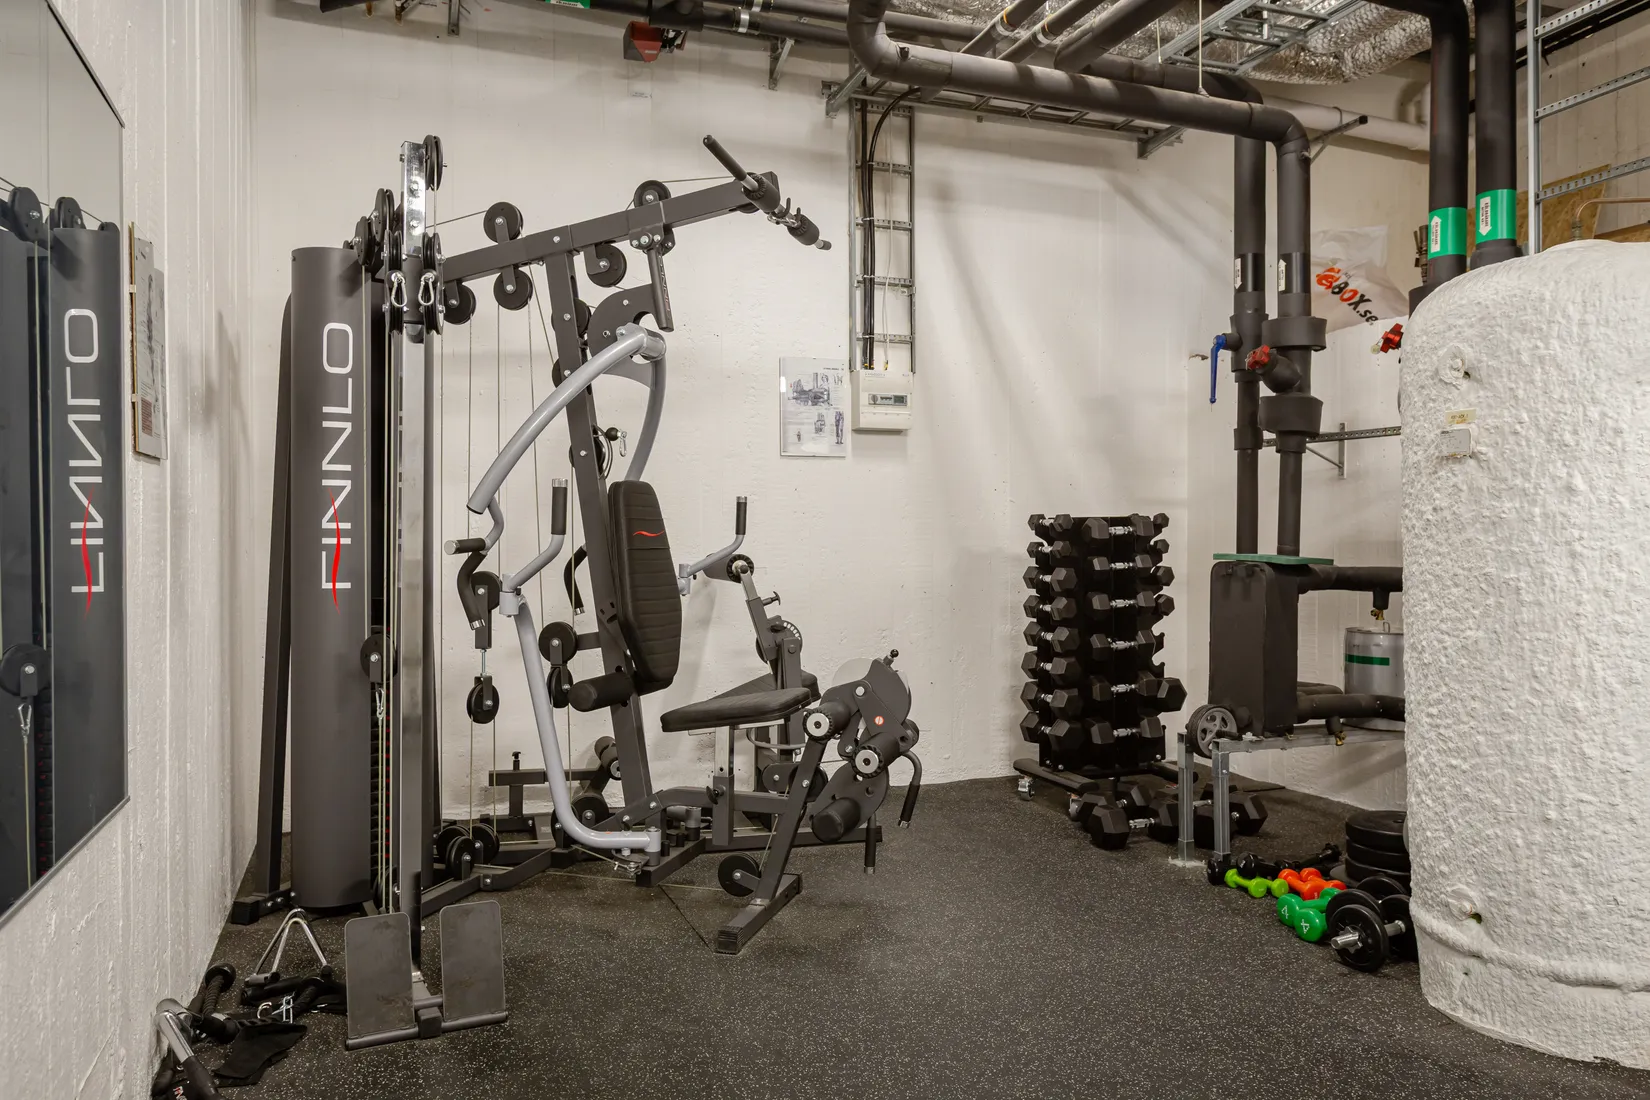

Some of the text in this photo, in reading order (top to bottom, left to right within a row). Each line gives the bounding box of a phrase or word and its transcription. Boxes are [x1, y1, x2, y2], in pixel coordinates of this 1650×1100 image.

[321, 322, 354, 589] FINNLO
[1281, 905, 1288, 919] 4
[1301, 919, 1310, 934] 4
